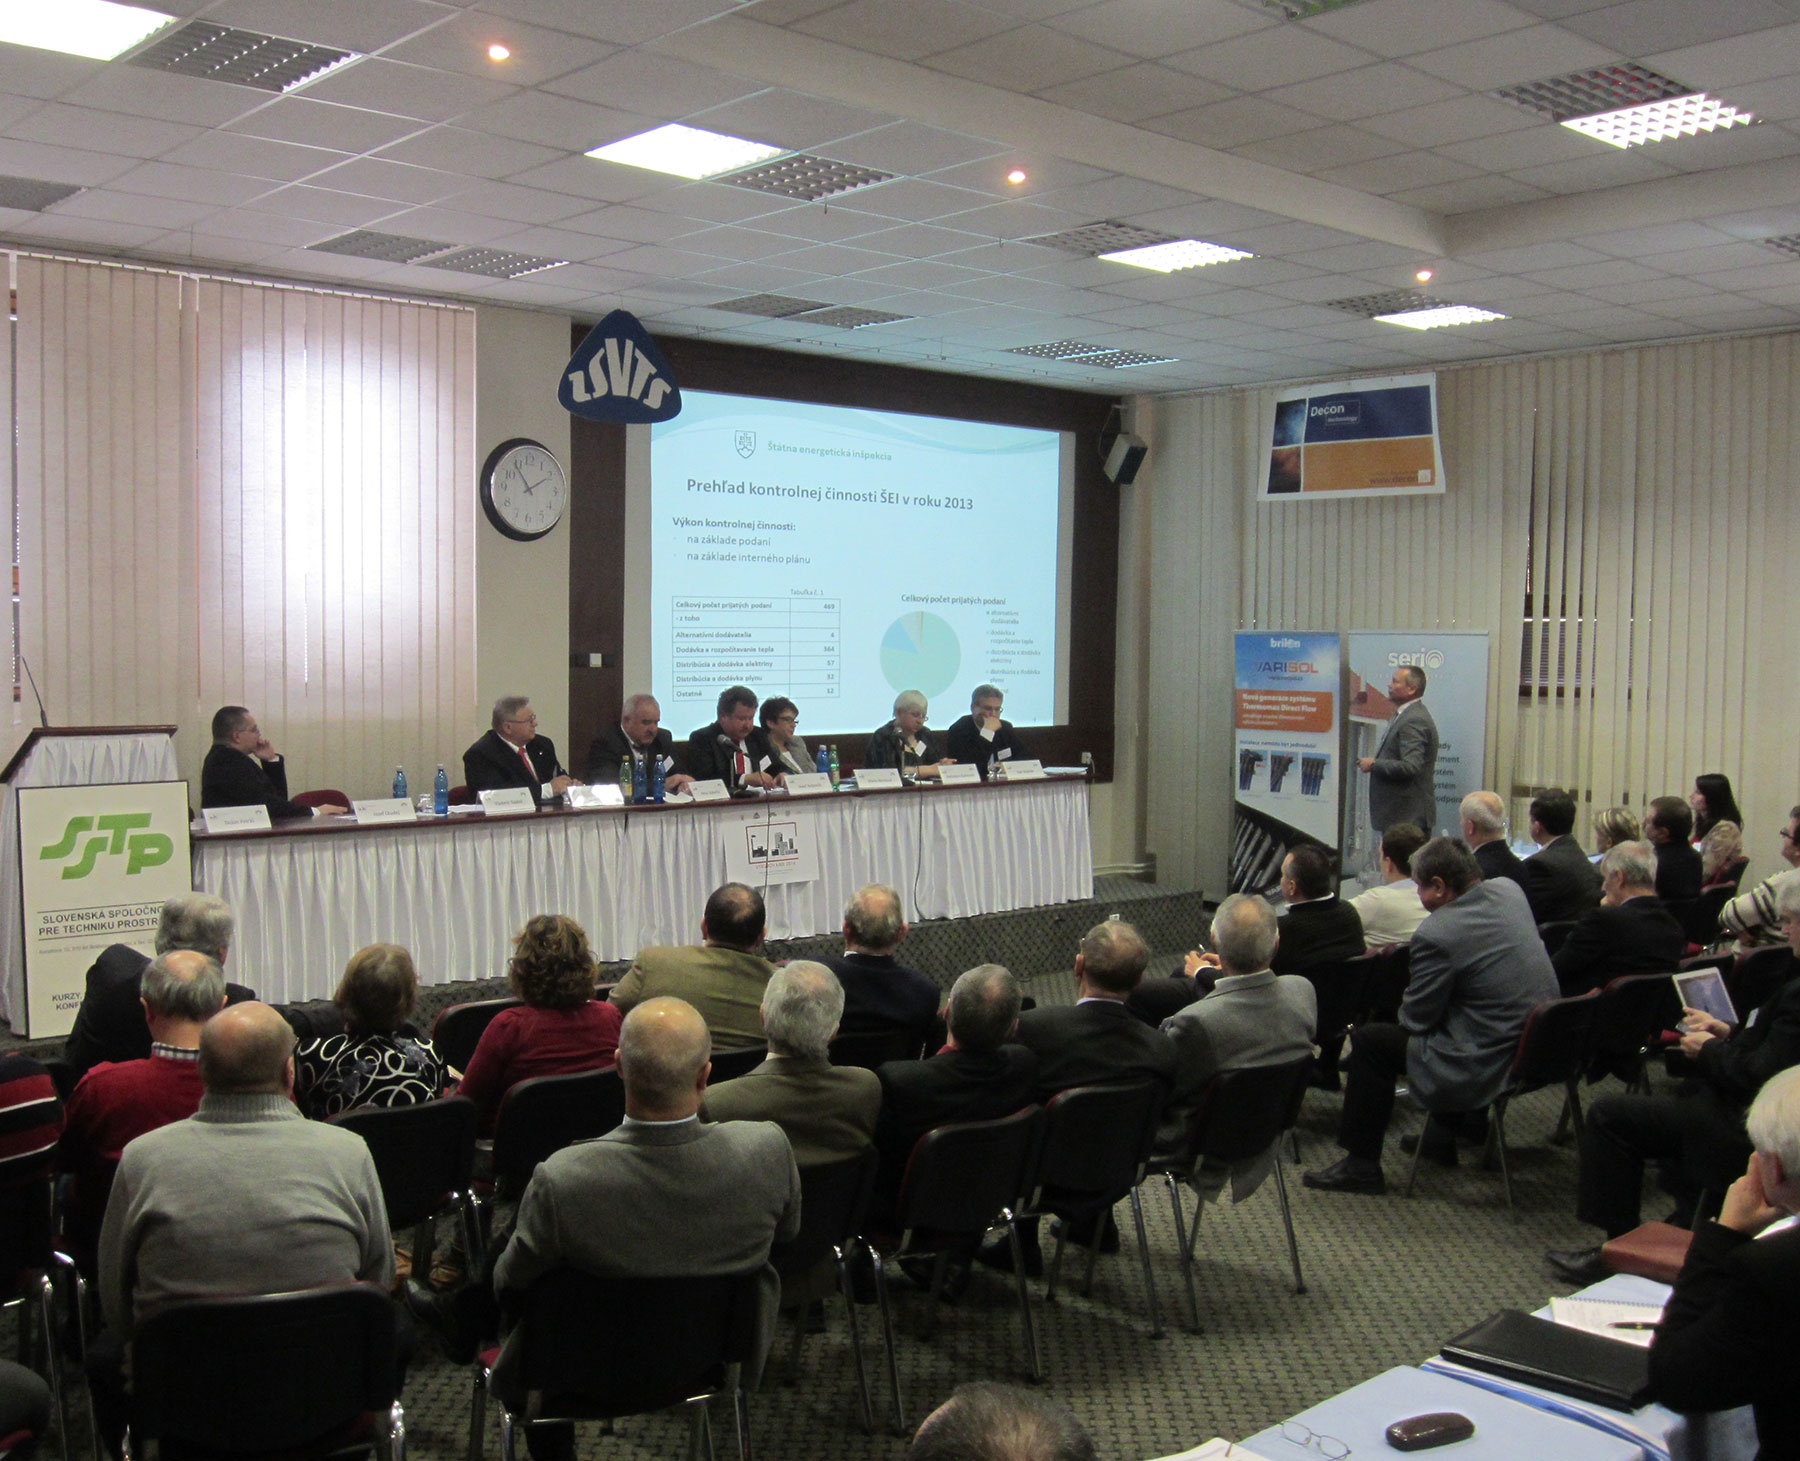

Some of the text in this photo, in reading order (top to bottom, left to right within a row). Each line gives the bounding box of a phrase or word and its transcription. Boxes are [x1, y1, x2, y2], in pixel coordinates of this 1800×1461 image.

[568, 338, 672, 409] ZSVTS
[1311, 405, 1345, 416] Decon
[768, 440, 892, 461] Štátna energetická inšpekcia
[525, 455, 535, 465] 12
[505, 470, 515, 479] 10
[501, 482, 507, 491] 9
[687, 478, 973, 510] Prehľad kontrolnej činnosti ŠEI v roku 2013
[504, 498, 510, 507] 8
[525, 513, 531, 523] 6
[672, 516, 796, 531] Výkon kontrolnej činnosti:
[687, 535, 771, 546] na základe podaní
[687, 552, 811, 564] na základe interného plánu
[676, 601, 701, 609] Celkový
[901, 593, 1006, 606] Celkový počet prijatých podaní
[758, 646, 774, 654] tepla
[42, 910, 105, 924] SLOVENSKÁ
[39, 917, 159, 936] PRE TECHNIKU PROSTR
[56, 1001, 80, 1010] KONF
